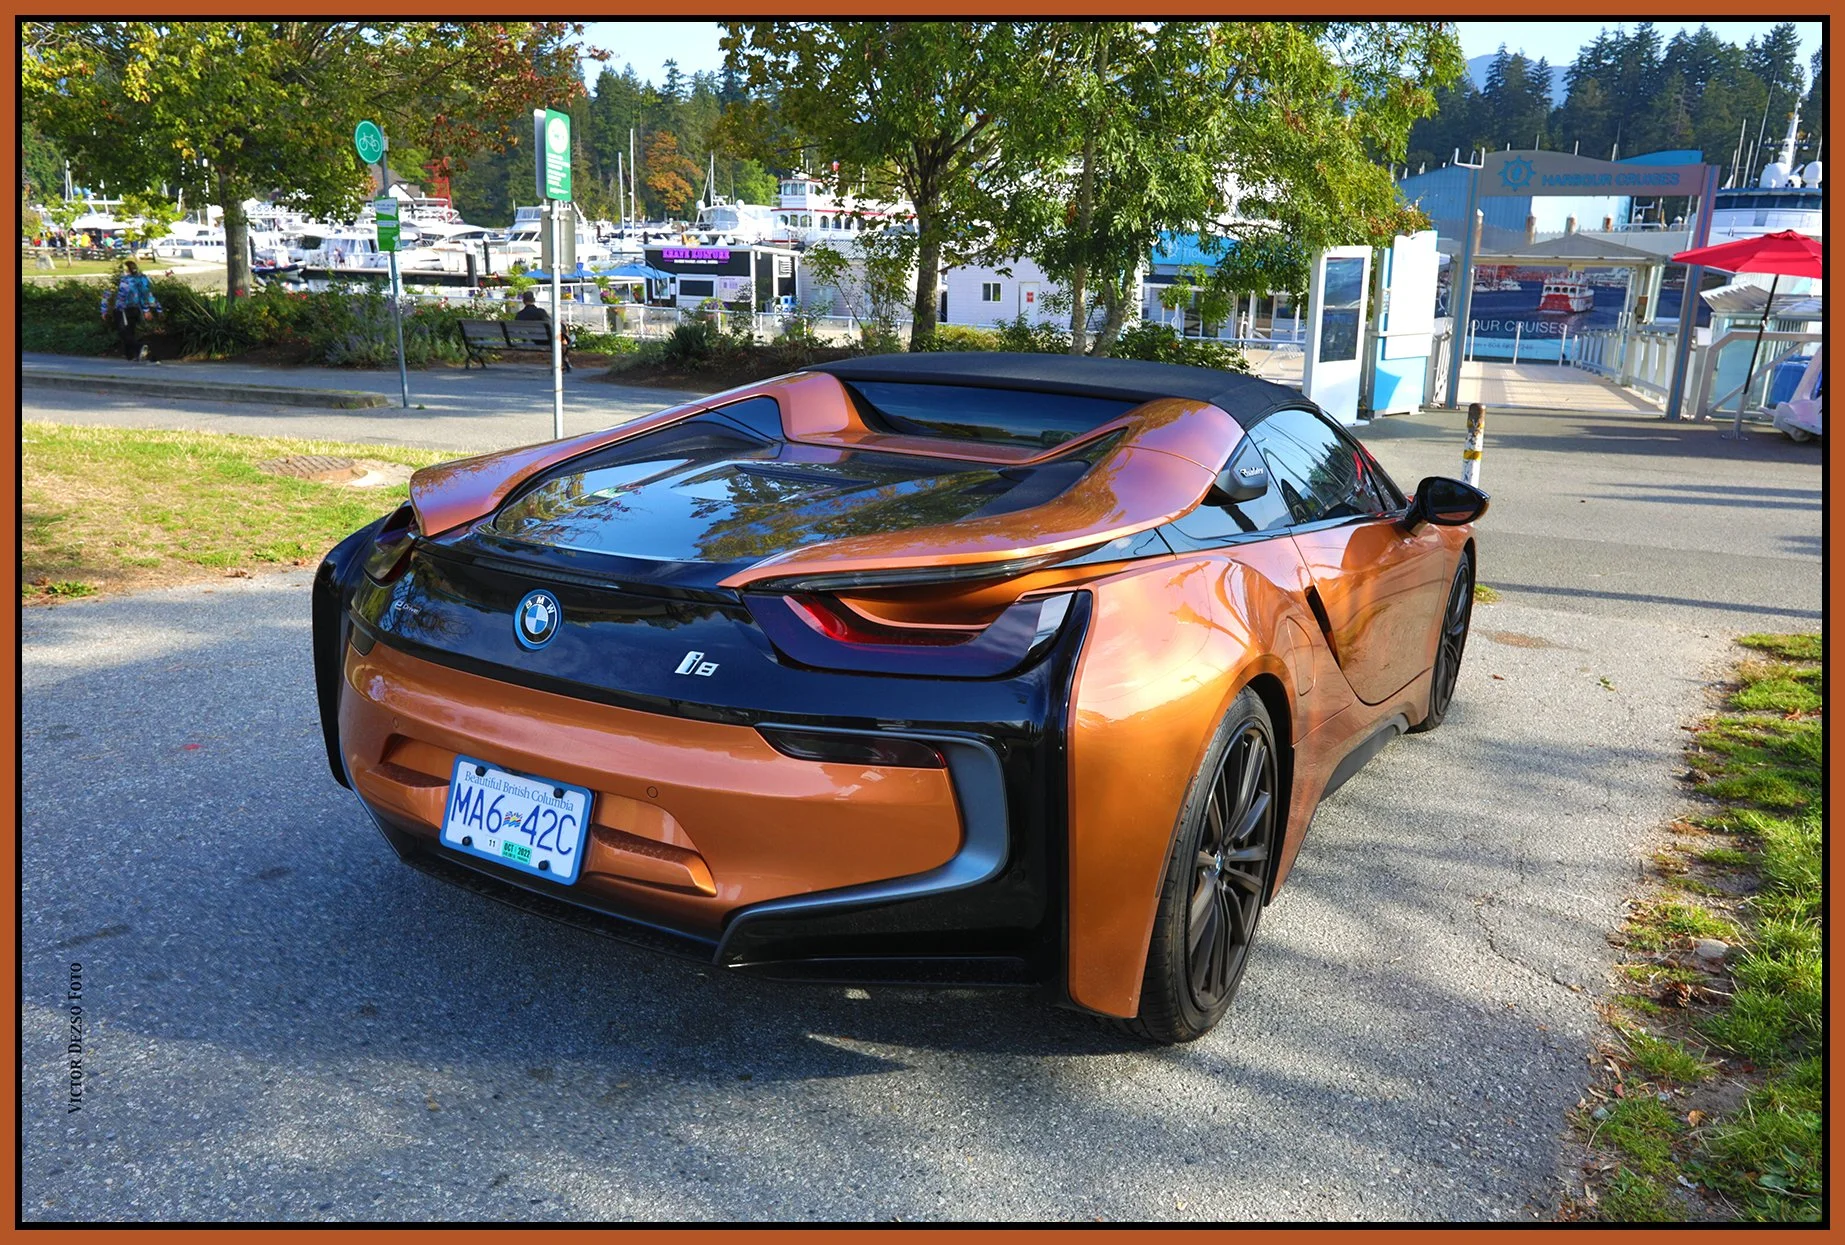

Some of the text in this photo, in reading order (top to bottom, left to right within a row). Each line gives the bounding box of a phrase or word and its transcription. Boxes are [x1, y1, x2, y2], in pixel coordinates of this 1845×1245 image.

[1541, 172, 1680, 187] HARBOUR CRUISES
[1504, 320, 1567, 335] CRUISES
[525, 596, 555, 614] BMW
[674, 650, 720, 677] i8
[464, 770, 575, 812] Beautiful British Columbia
[450, 782, 577, 856] MA6 42C
[503, 842, 515, 853] OCT
[517, 846, 531, 859] 2022
